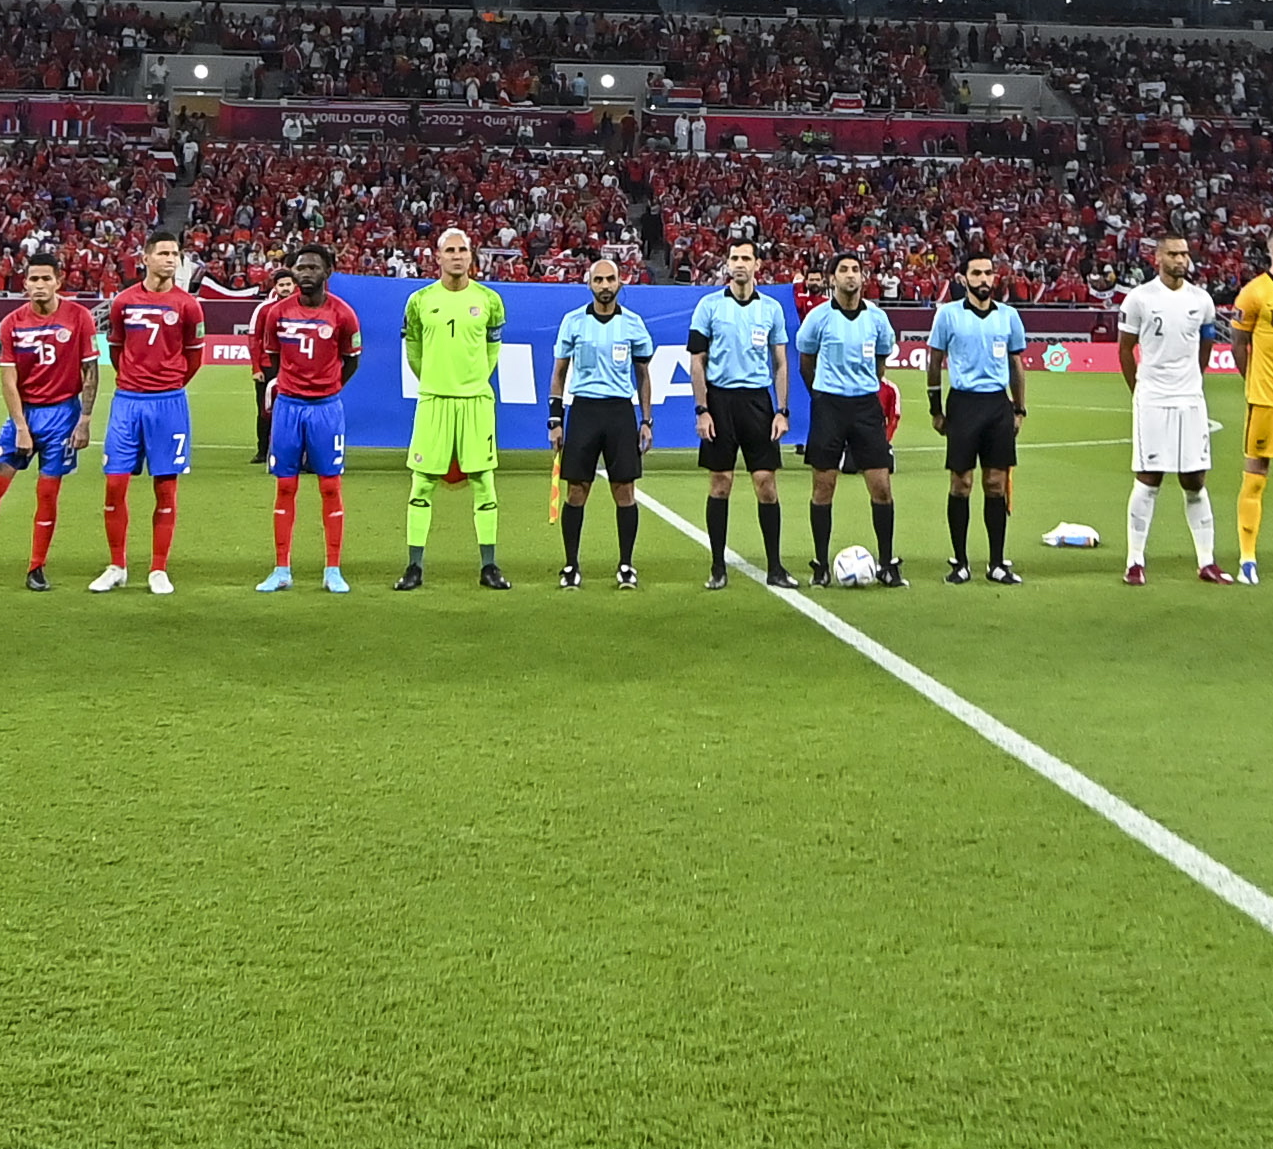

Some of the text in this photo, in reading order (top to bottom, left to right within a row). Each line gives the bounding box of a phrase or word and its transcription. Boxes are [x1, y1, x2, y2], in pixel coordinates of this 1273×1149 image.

[353, 114, 376, 124] CUP
[145, 323, 159, 345] 7
[447, 319, 455, 337] 1
[1153, 316, 1163, 336] 2
[34, 342, 56, 365] 13
[213, 345, 251, 360] FIFA
[299, 335, 314, 359] 4
[173, 433, 185, 455] 7
[334, 434, 344, 456] 4
[487, 434, 493, 453] 1
